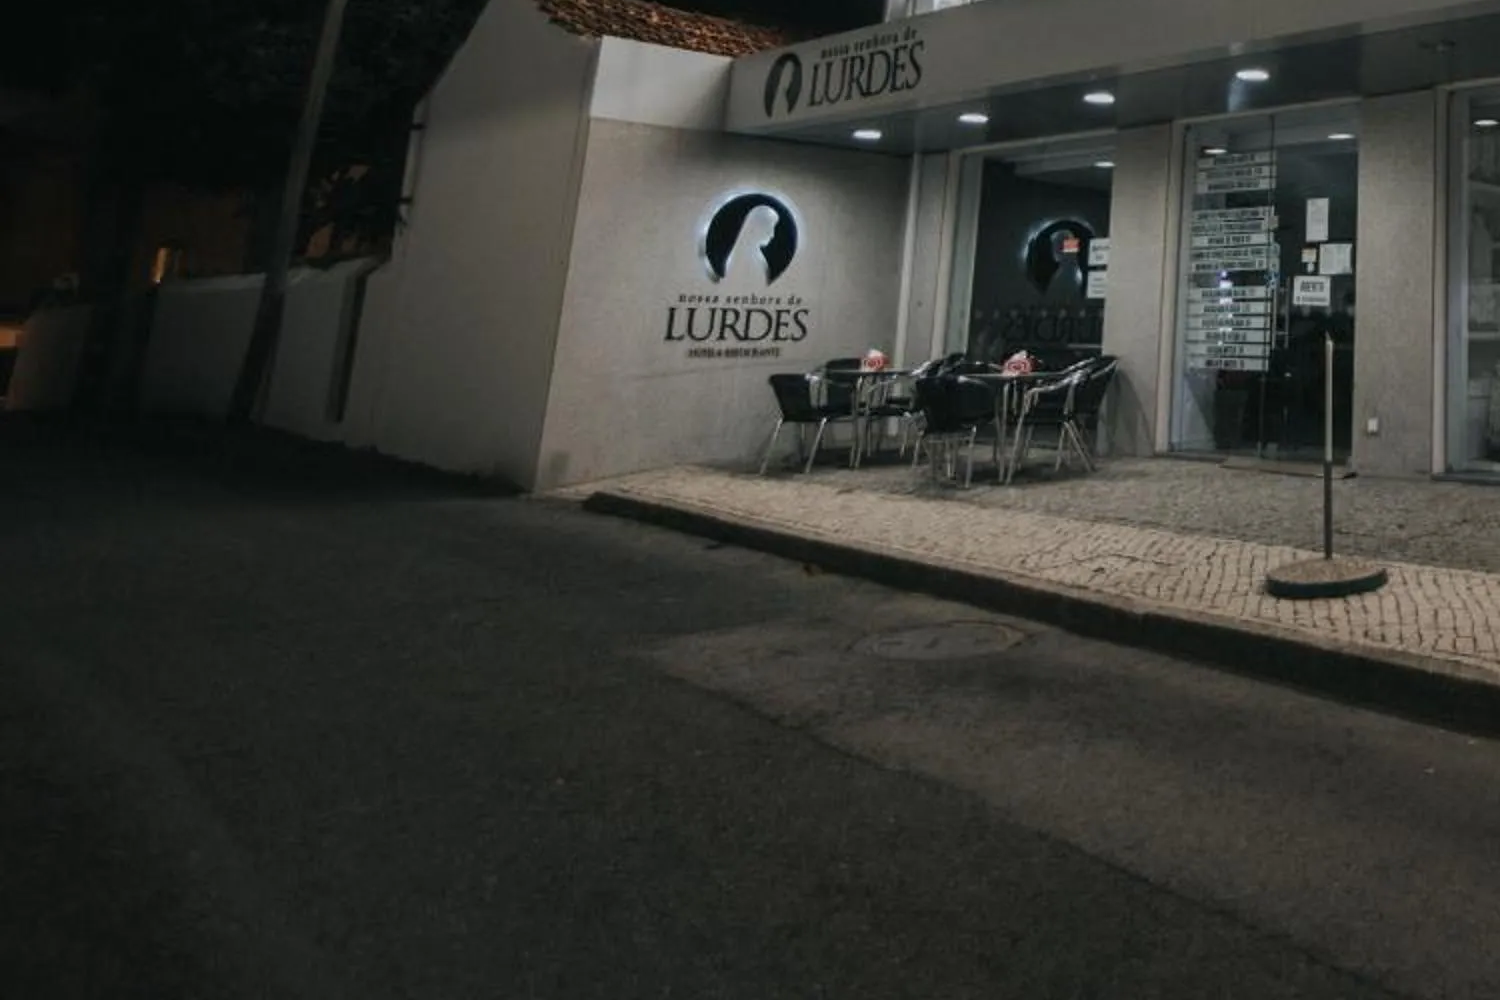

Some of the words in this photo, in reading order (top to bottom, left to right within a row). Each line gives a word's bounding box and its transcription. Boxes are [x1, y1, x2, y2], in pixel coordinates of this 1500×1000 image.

[807, 40, 924, 107] LURDES
[787, 293, 803, 305] de
[664, 307, 810, 342] LURDES
